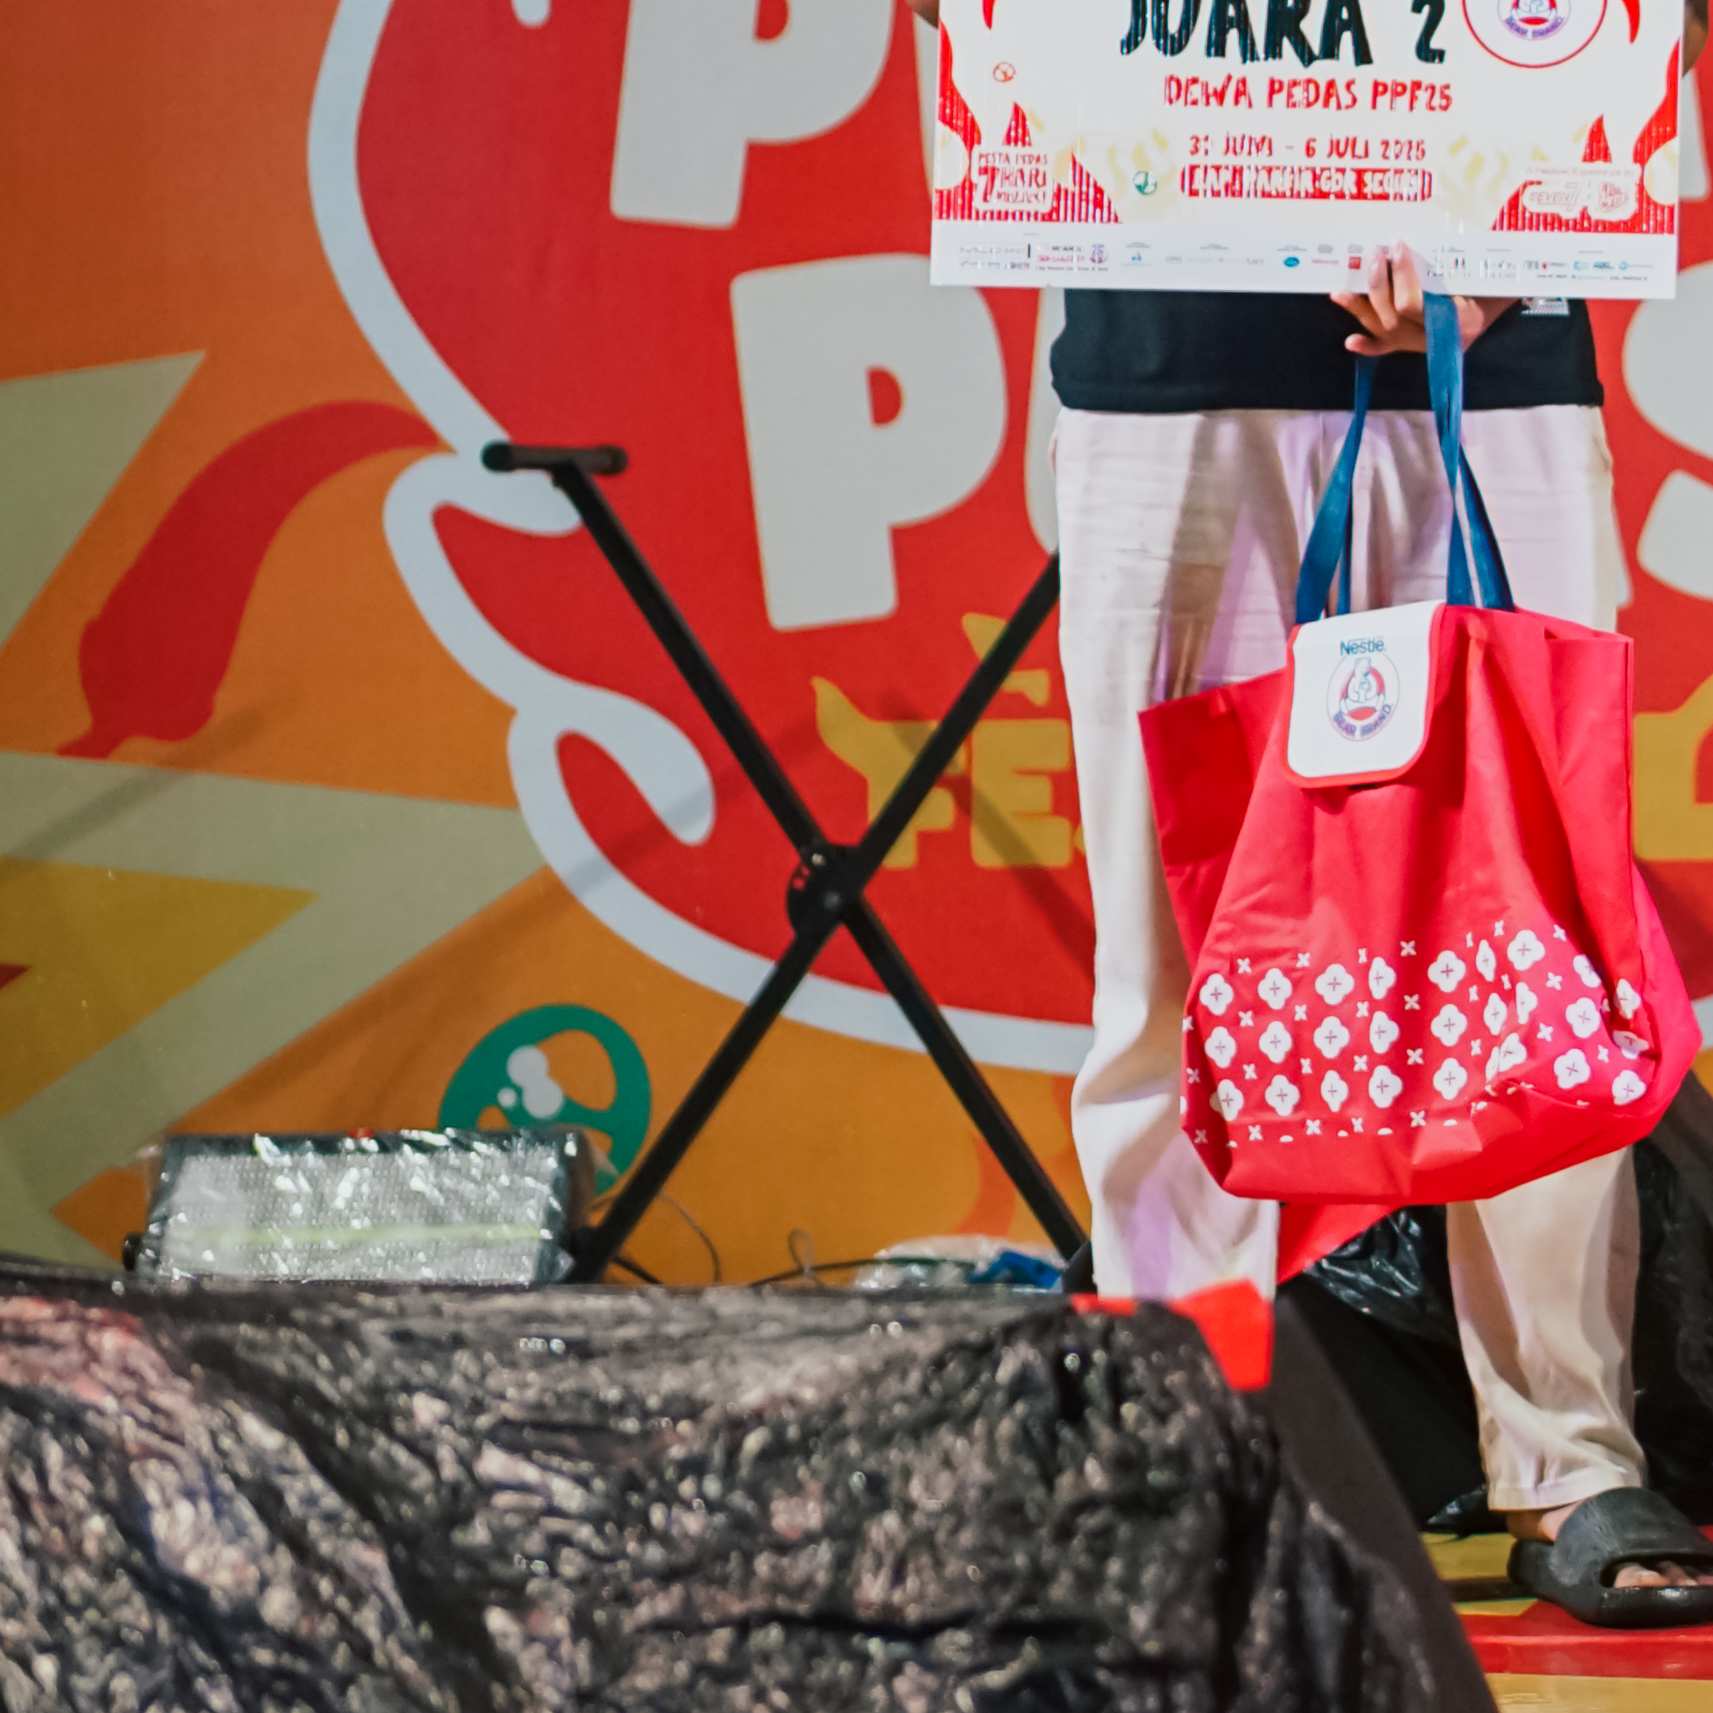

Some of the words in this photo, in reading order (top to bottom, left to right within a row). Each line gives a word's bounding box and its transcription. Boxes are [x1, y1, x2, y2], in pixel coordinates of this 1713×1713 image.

[1165, 73, 1253, 109] DEWA
[1267, 76, 1358, 110] PEDAS
[1371, 78, 1453, 112] PPF25
[1305, 138, 1316, 158] 6
